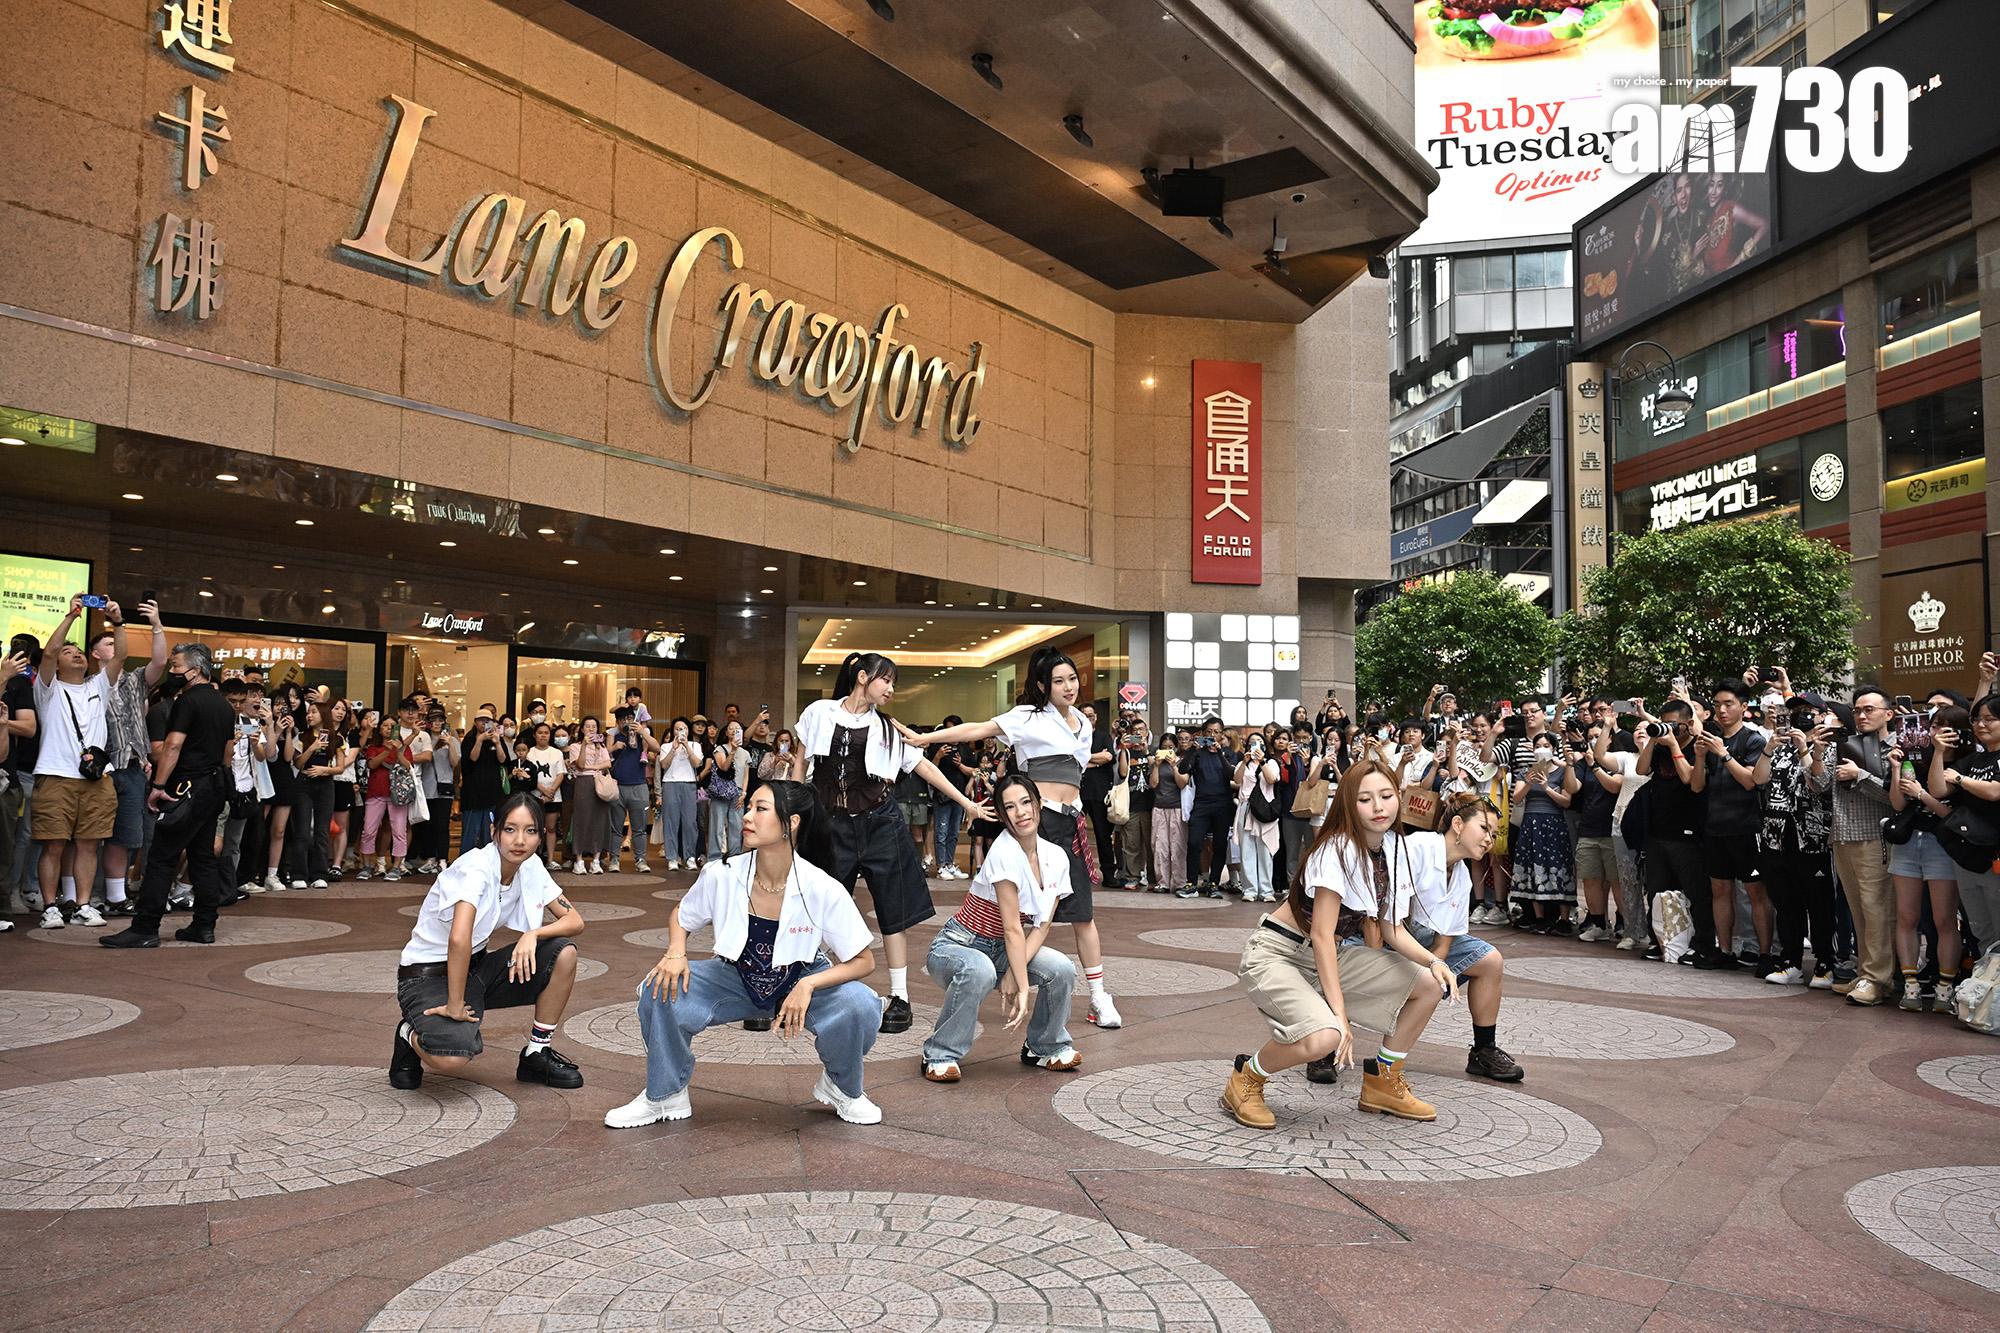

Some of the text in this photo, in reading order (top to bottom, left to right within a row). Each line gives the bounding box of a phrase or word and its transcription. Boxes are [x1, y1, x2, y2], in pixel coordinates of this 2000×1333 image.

[1440, 97, 1565, 136] Ruby
[1495, 167, 1602, 201] Optimus
[340, 94, 989, 453] Lane Crawford
[1204, 390, 1252, 522] 食通天
[1204, 535, 1251, 545] FOOD
[1204, 546, 1251, 557] FORUM
[1400, 535, 1430, 554] EuroEyes
[422, 612, 484, 635] Lane Crawford
[1893, 649, 1965, 669] EMPEROR
[1456, 755, 1484, 778] Winka
[1408, 795, 1433, 811] MUJI
